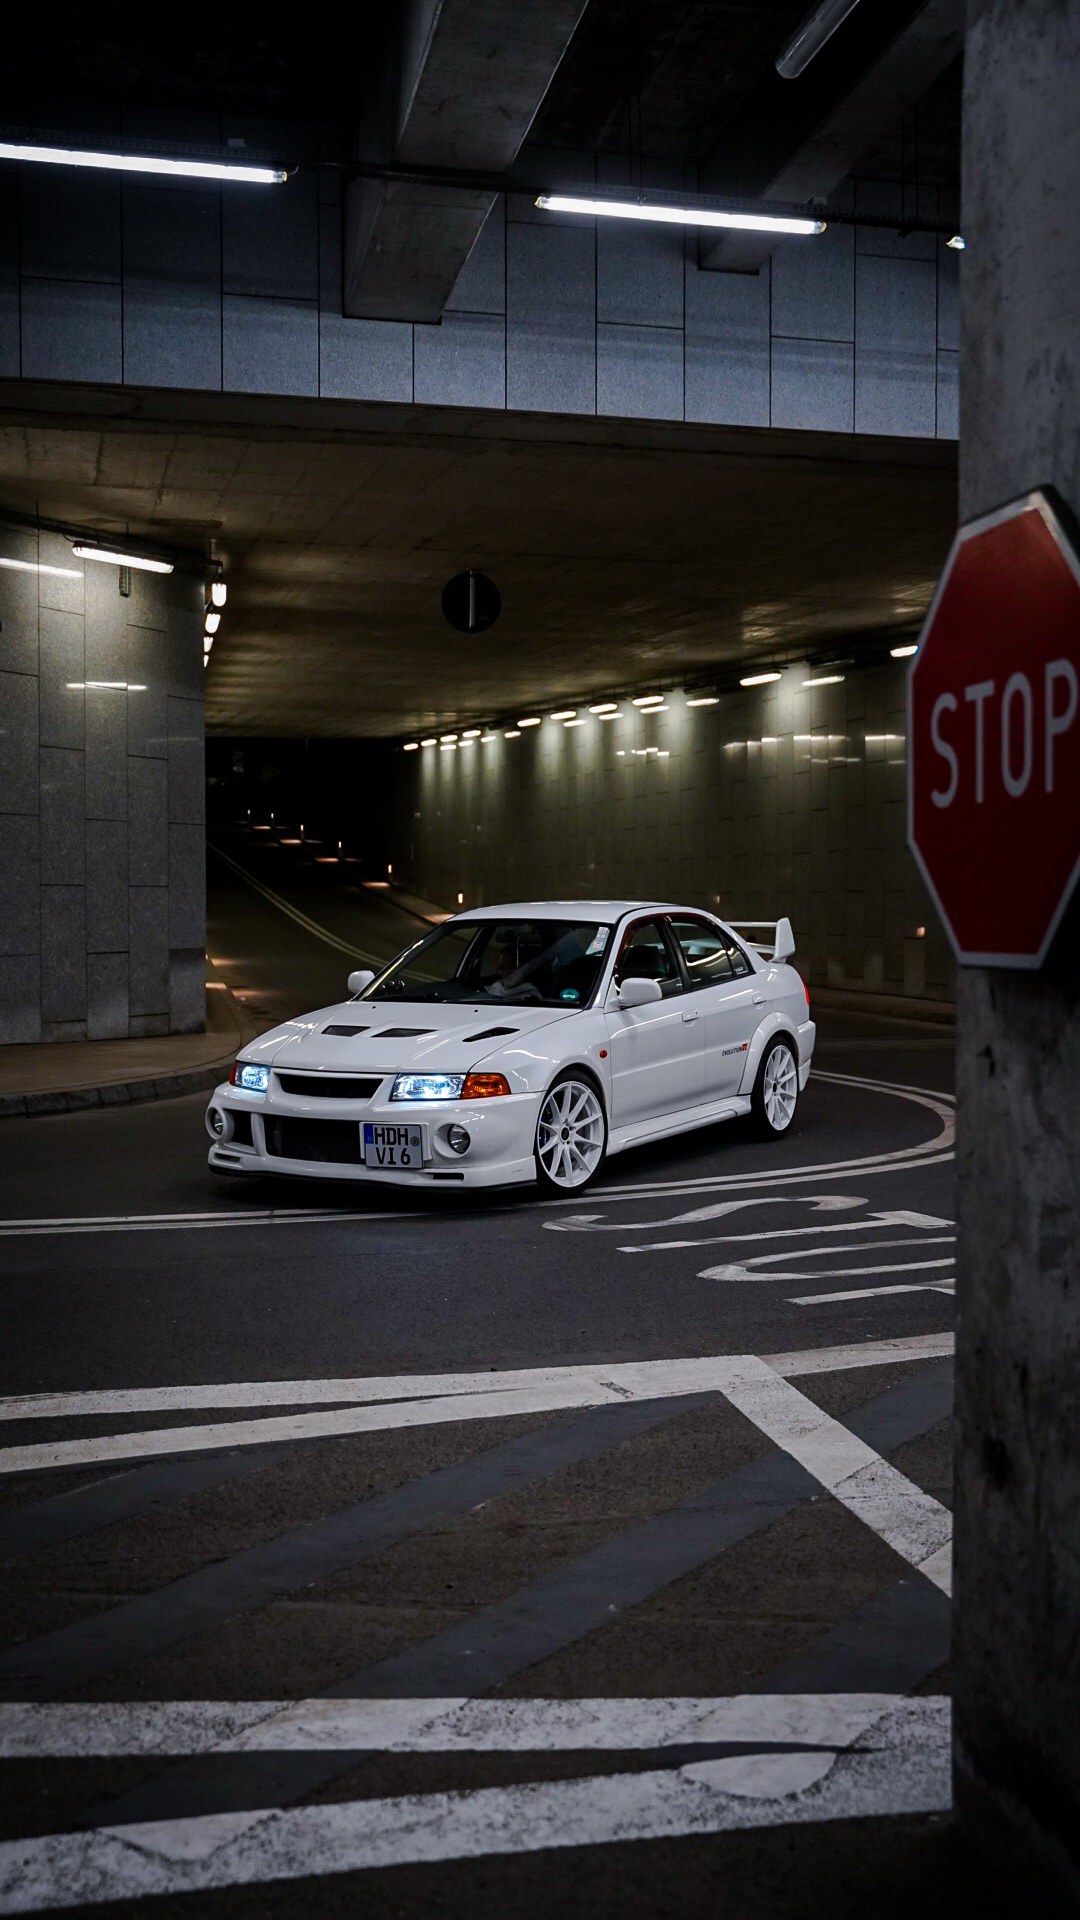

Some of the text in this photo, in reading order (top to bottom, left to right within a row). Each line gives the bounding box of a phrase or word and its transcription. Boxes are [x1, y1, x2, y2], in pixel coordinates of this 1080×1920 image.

[930, 658, 1079, 809] STOP
[374, 1127, 408, 1145] HDH
[376, 1147, 411, 1165] VI 6
